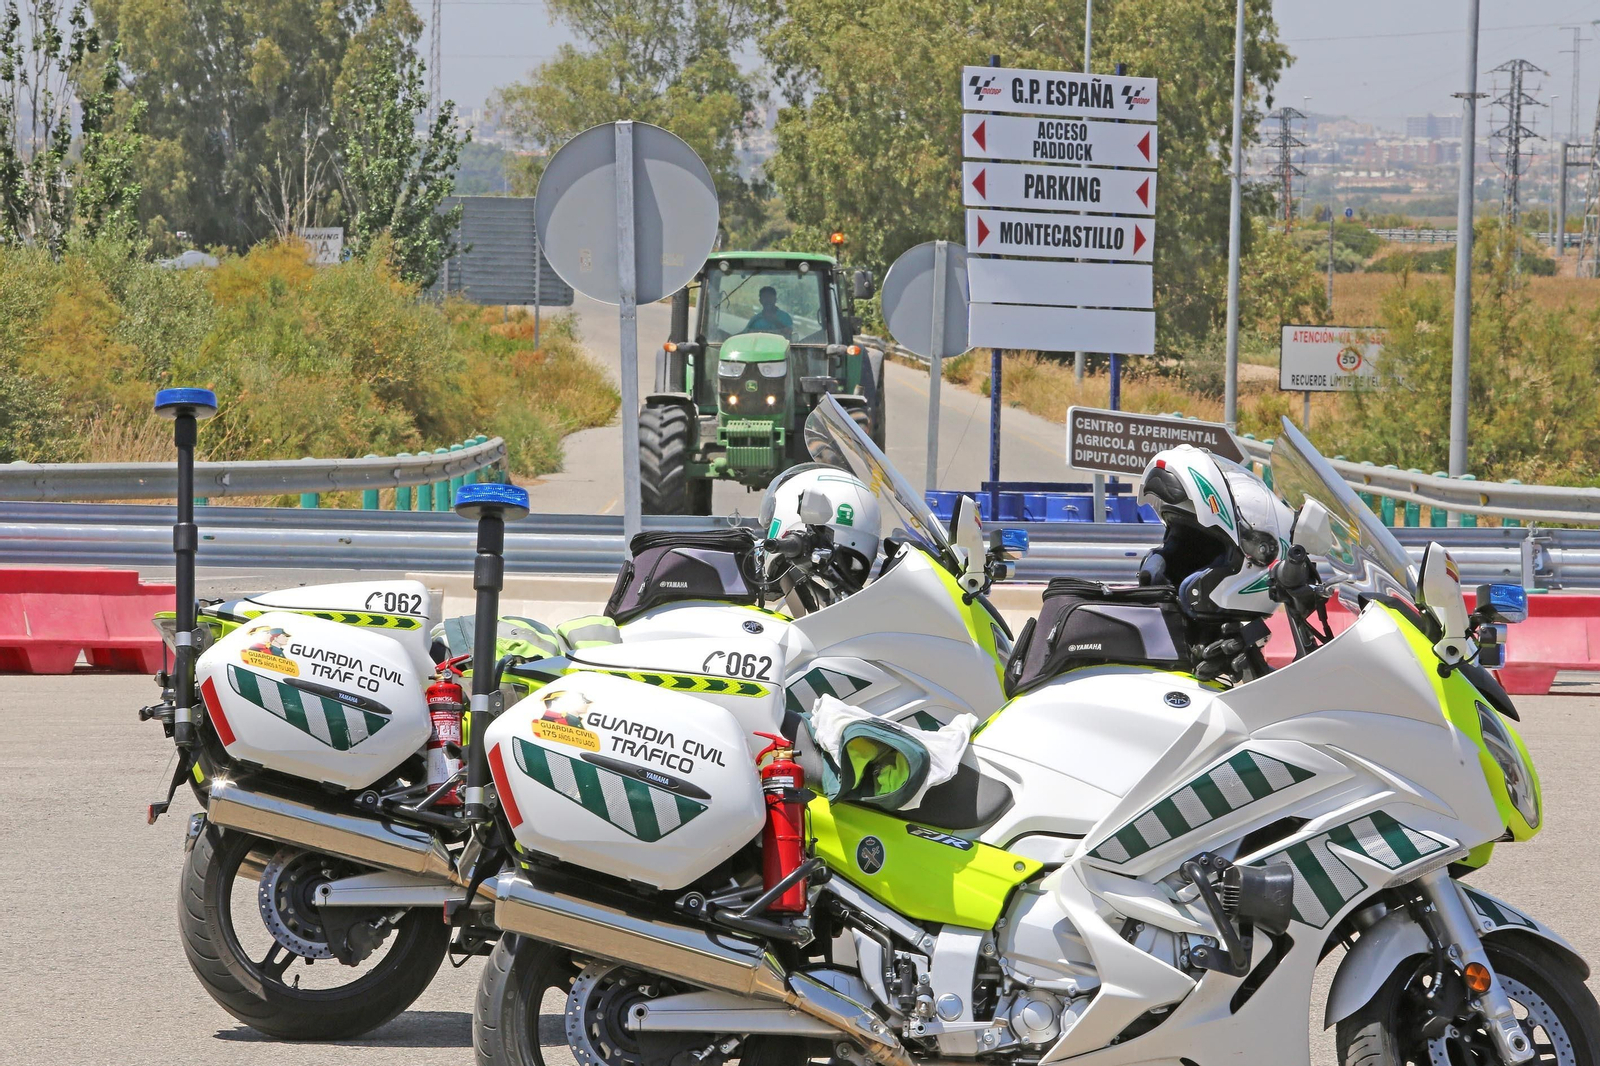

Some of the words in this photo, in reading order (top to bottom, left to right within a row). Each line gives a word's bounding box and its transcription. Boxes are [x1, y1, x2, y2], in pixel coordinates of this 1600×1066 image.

[1012, 78, 1041, 104] G.P.
[1046, 78, 1114, 108] ESPAÑA
[1037, 122, 1088, 142] ACCESO
[1033, 140, 1092, 161] PADDOCK
[1024, 174, 1101, 202] PARKING
[1000, 222, 1124, 250] MONTECASTILLO
[1292, 328, 1334, 343] ATENCIÓN
[1291, 374, 1327, 386] RECUERDE
[1076, 418, 1124, 434] CENTRO
[1130, 424, 1218, 444] EXPERIMENTAL
[1076, 434, 1135, 450] AGRICOLA
[1075, 450, 1146, 468] DIPUTACION
[666, 580, 688, 588] YAMAHA
[384, 592, 422, 614] 062
[248, 652, 277, 662] GUARDIA
[278, 658, 295, 666] CIVIL
[290, 644, 363, 672] GUARDIA
[370, 664, 404, 686] CIVIL
[725, 652, 772, 680] 062
[338, 692, 358, 704] YAMAHA
[540, 722, 574, 734] GUARDIA
[576, 730, 594, 740] CIVIL
[542, 730, 557, 738] 175
[586, 712, 675, 748] GUARDIA
[682, 739, 726, 768] CIVIL
[611, 735, 694, 774] TRÁFICO
[646, 771, 670, 786] YAMAHA
[910, 826, 969, 849] FJR
